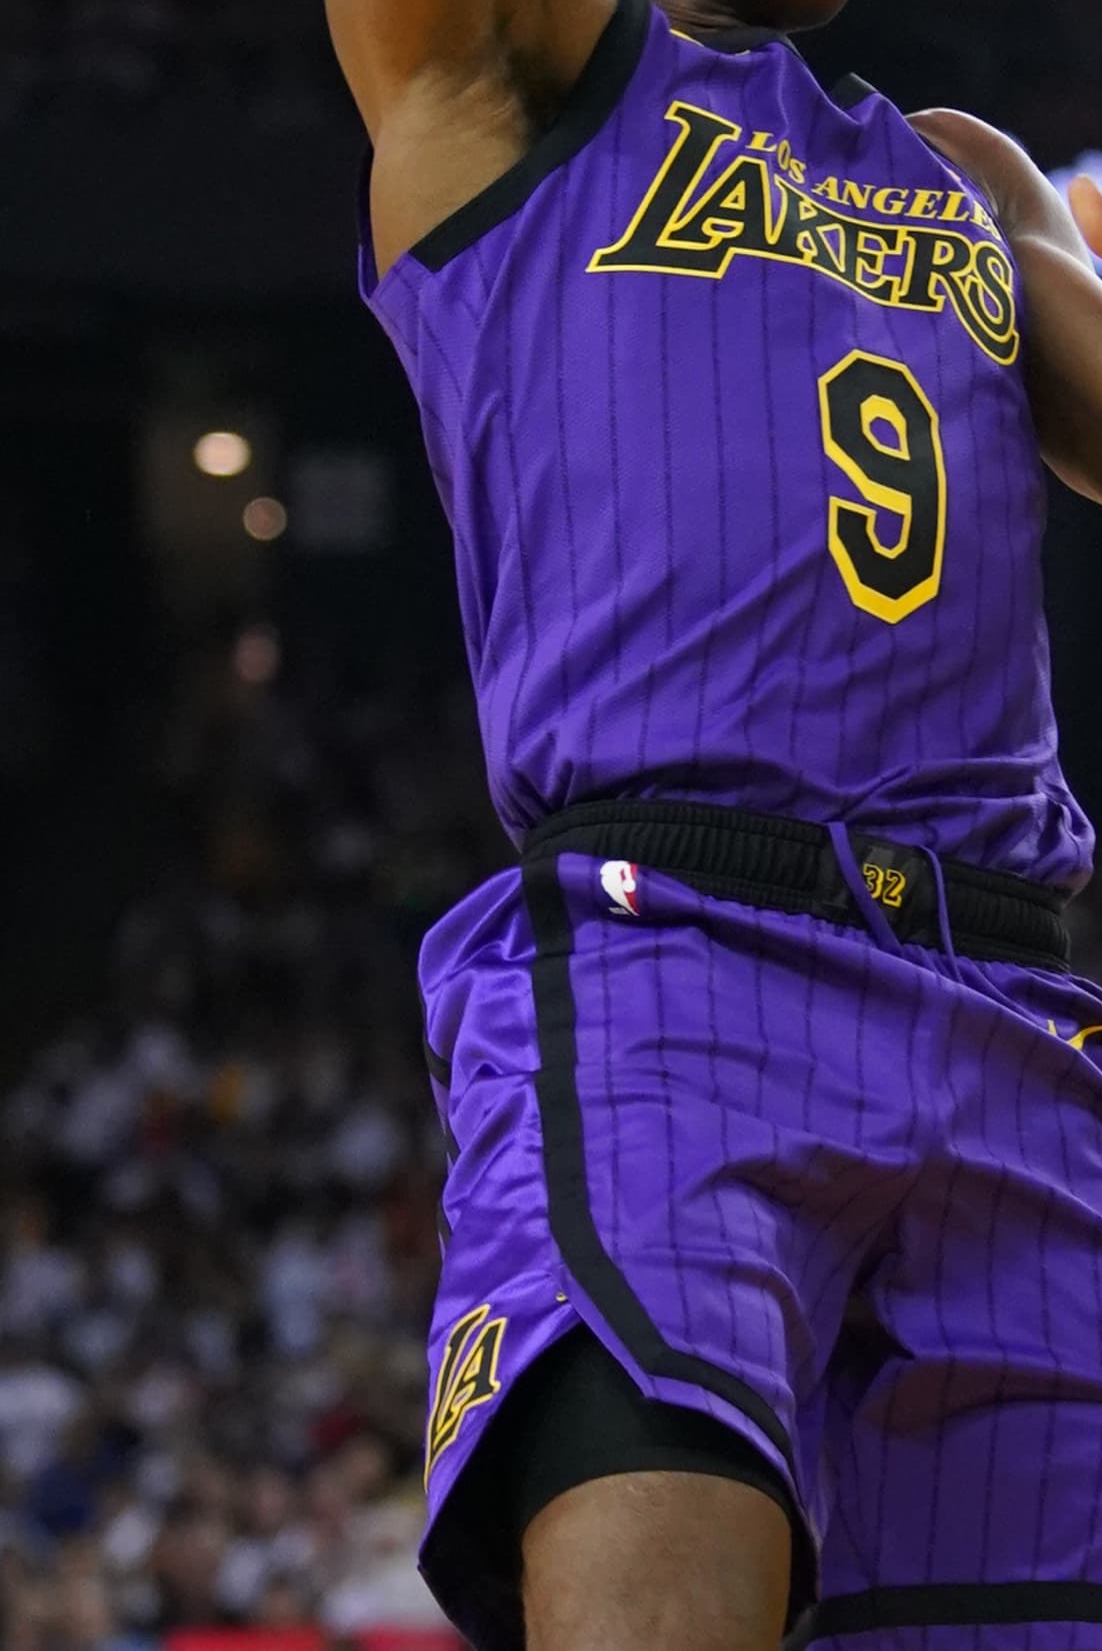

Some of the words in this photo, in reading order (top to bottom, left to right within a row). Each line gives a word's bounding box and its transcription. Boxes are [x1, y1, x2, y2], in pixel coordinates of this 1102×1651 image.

[585, 100, 1020, 365] LAKERS
[745, 130, 807, 184] LOS
[818, 349, 947, 625] 9
[863, 862, 906, 908] 32
